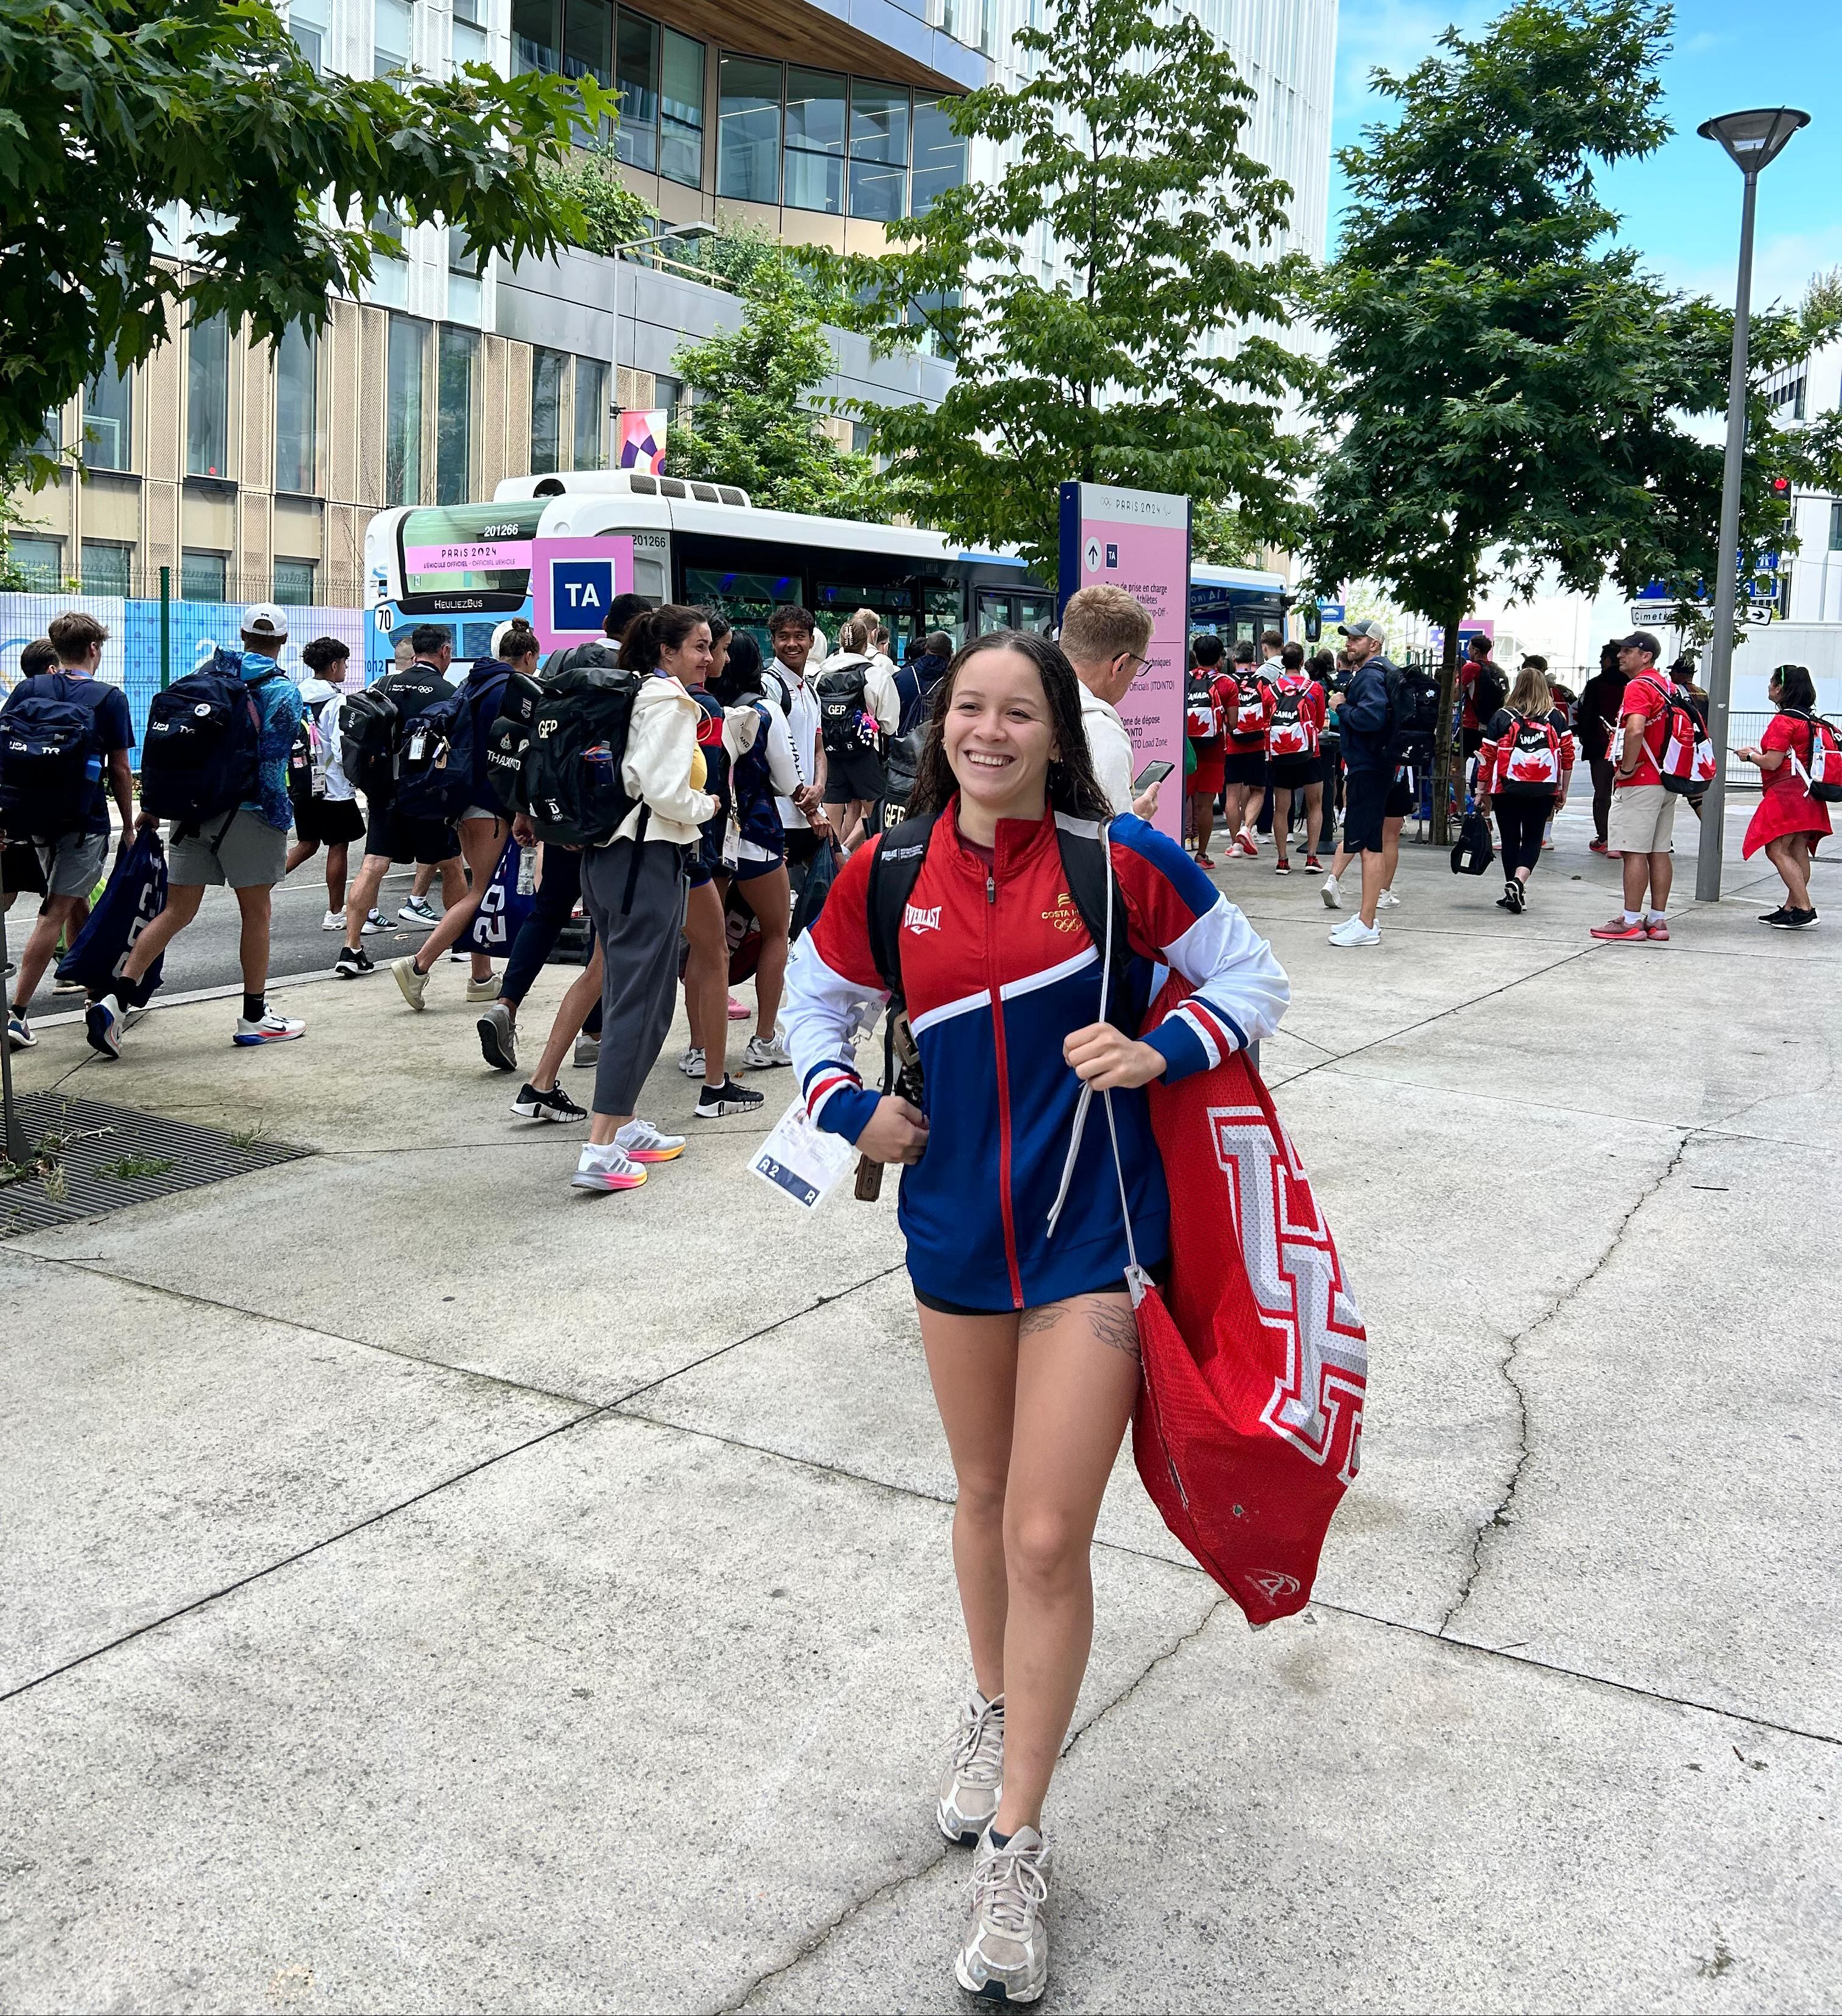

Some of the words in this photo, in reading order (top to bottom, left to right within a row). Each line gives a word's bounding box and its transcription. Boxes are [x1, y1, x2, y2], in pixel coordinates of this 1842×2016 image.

[1116, 499, 1138, 512] PARIS
[1141, 503, 1160, 514] 2024
[484, 523, 519, 537] 201266
[632, 535, 666, 548] 201266
[442, 548, 468, 558] PARIS
[471, 547, 496, 557] 2024
[1108, 551, 1116, 560] TA
[565, 583, 600, 607] TA
[1120, 582, 1127, 591] de
[1128, 583, 1142, 593] prise
[1143, 584, 1149, 593] en
[1150, 583, 1168, 596] charge
[378, 609, 391, 630] 70
[1635, 611, 1671, 621] Cimeti
[1129, 680, 1149, 691] Officials
[1120, 717, 1133, 726] Zone
[1134, 716, 1141, 725] de
[1142, 714, 1160, 726] dépose
[9, 741, 27, 752] USA
[1143, 739, 1154, 748] Load
[1156, 738, 1168, 747] Zone
[904, 903, 942, 931] EVERLAST
[1041, 909, 1070, 919] COSTA
[804, 1190, 816, 1203] R
